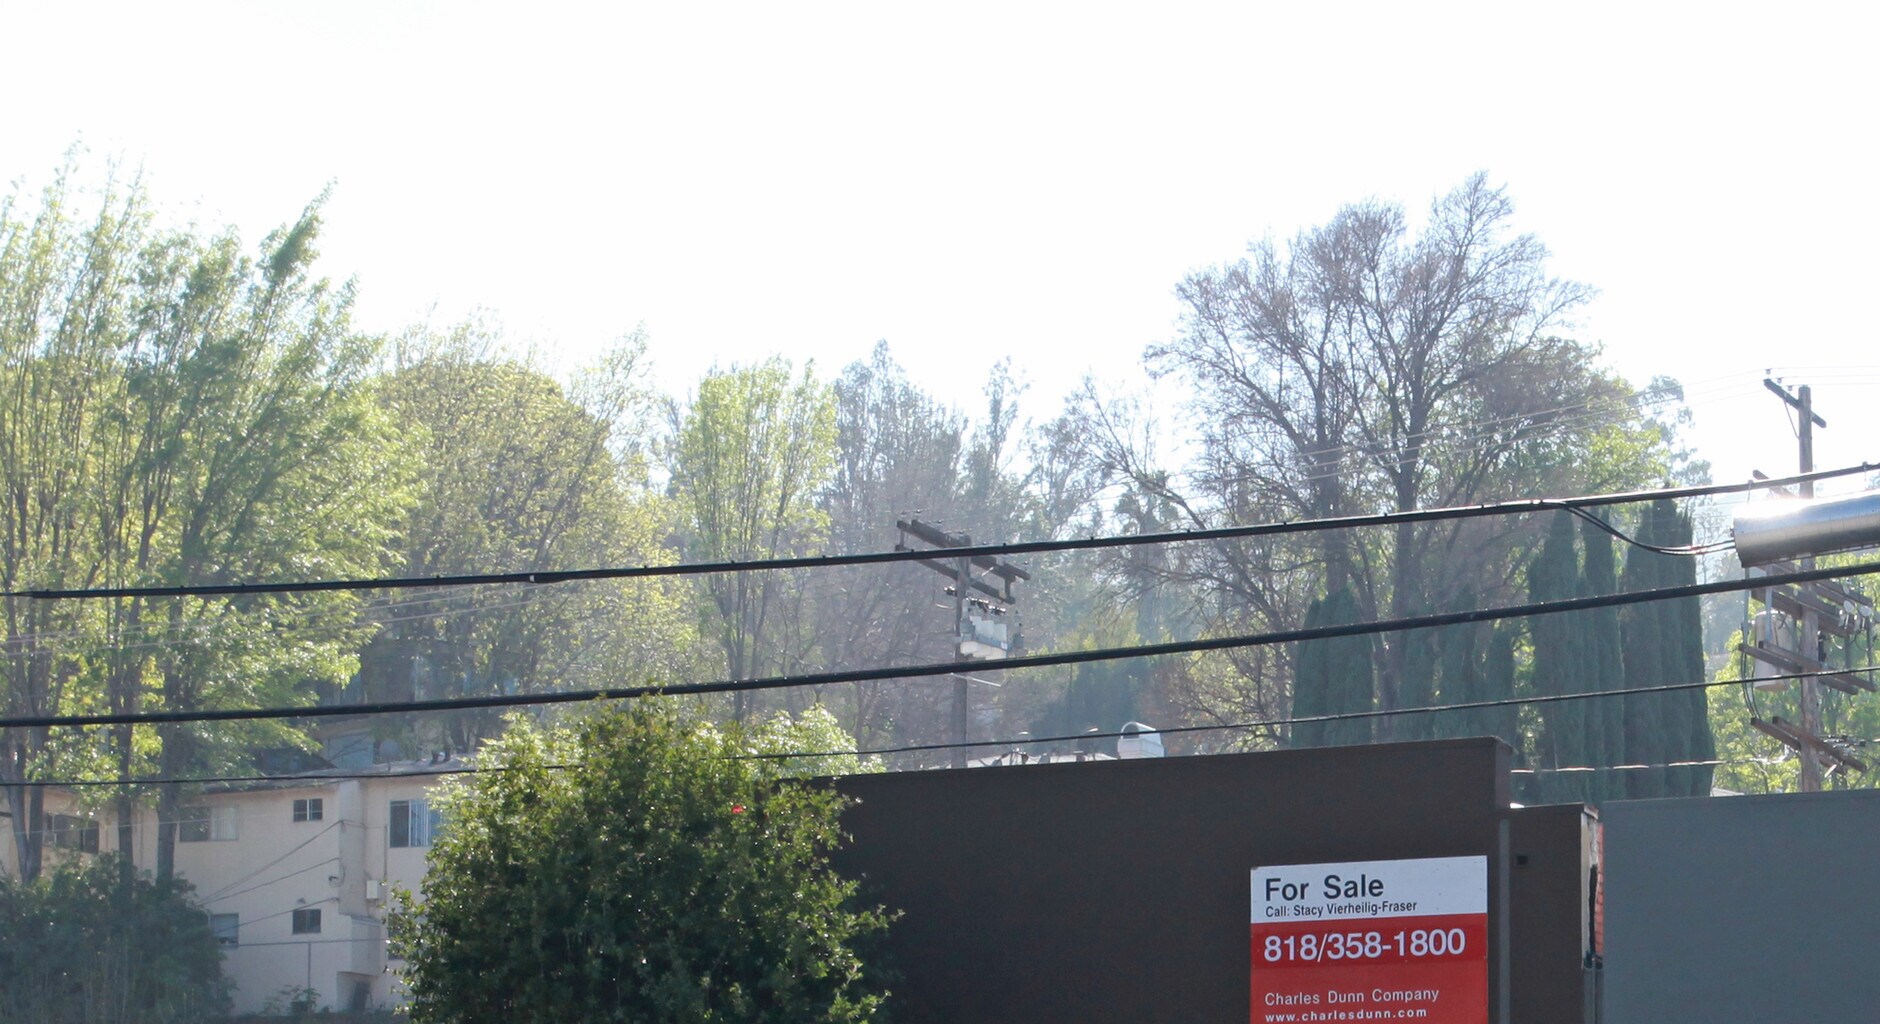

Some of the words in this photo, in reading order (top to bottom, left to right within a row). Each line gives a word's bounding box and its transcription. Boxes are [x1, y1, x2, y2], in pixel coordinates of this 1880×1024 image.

[1265, 877, 1309, 901] For
[1323, 874, 1384, 899] Sale
[1265, 906, 1290, 918] Call:
[1293, 903, 1324, 918] Stacy
[1326, 901, 1418, 916] Vierheilig-Fraser
[1263, 928, 1466, 962] 818/358-1800
[1264, 992, 1320, 1006] Charles
[1328, 989, 1365, 1004] Dunn
[1372, 988, 1440, 1003] Company
[1265, 1008, 1428, 1023] www.charlesdunn.com
